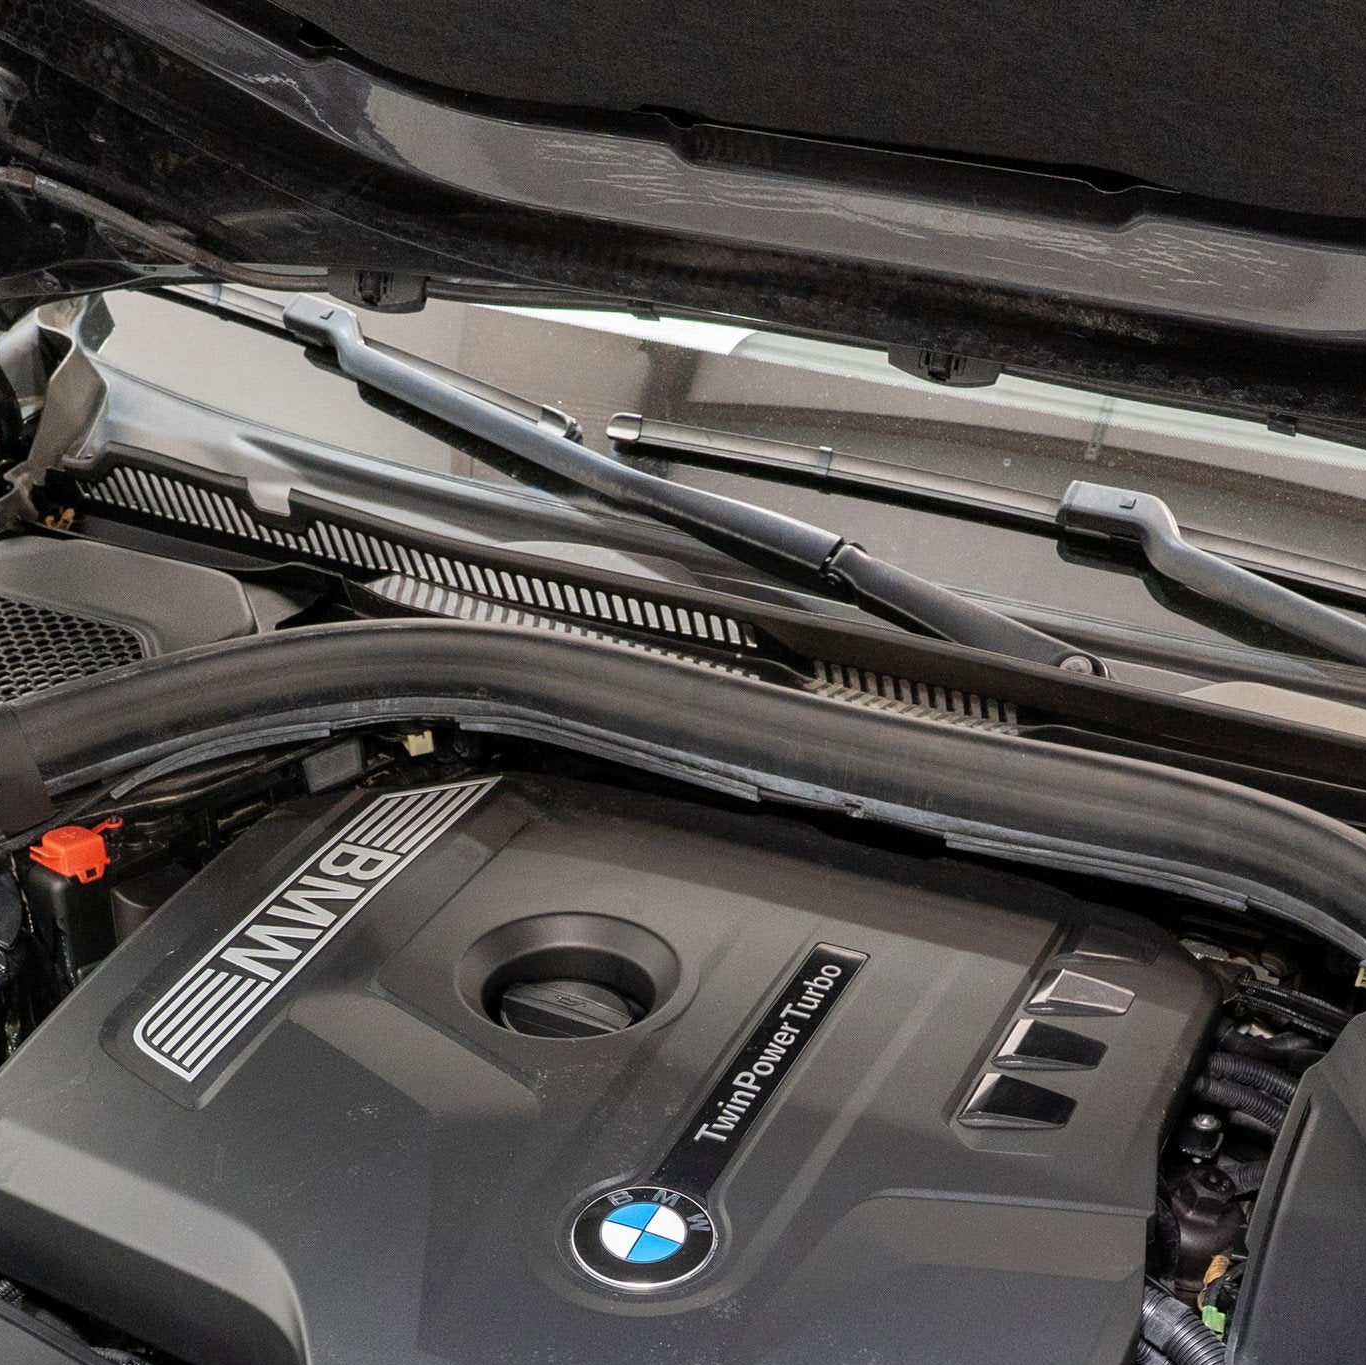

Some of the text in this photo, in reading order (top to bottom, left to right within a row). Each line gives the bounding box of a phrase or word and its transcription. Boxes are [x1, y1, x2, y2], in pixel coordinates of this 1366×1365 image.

[220, 842, 402, 982] BMW
[693, 964, 842, 1143] TwinPower Turbo
[607, 1189, 711, 1233] BMW
